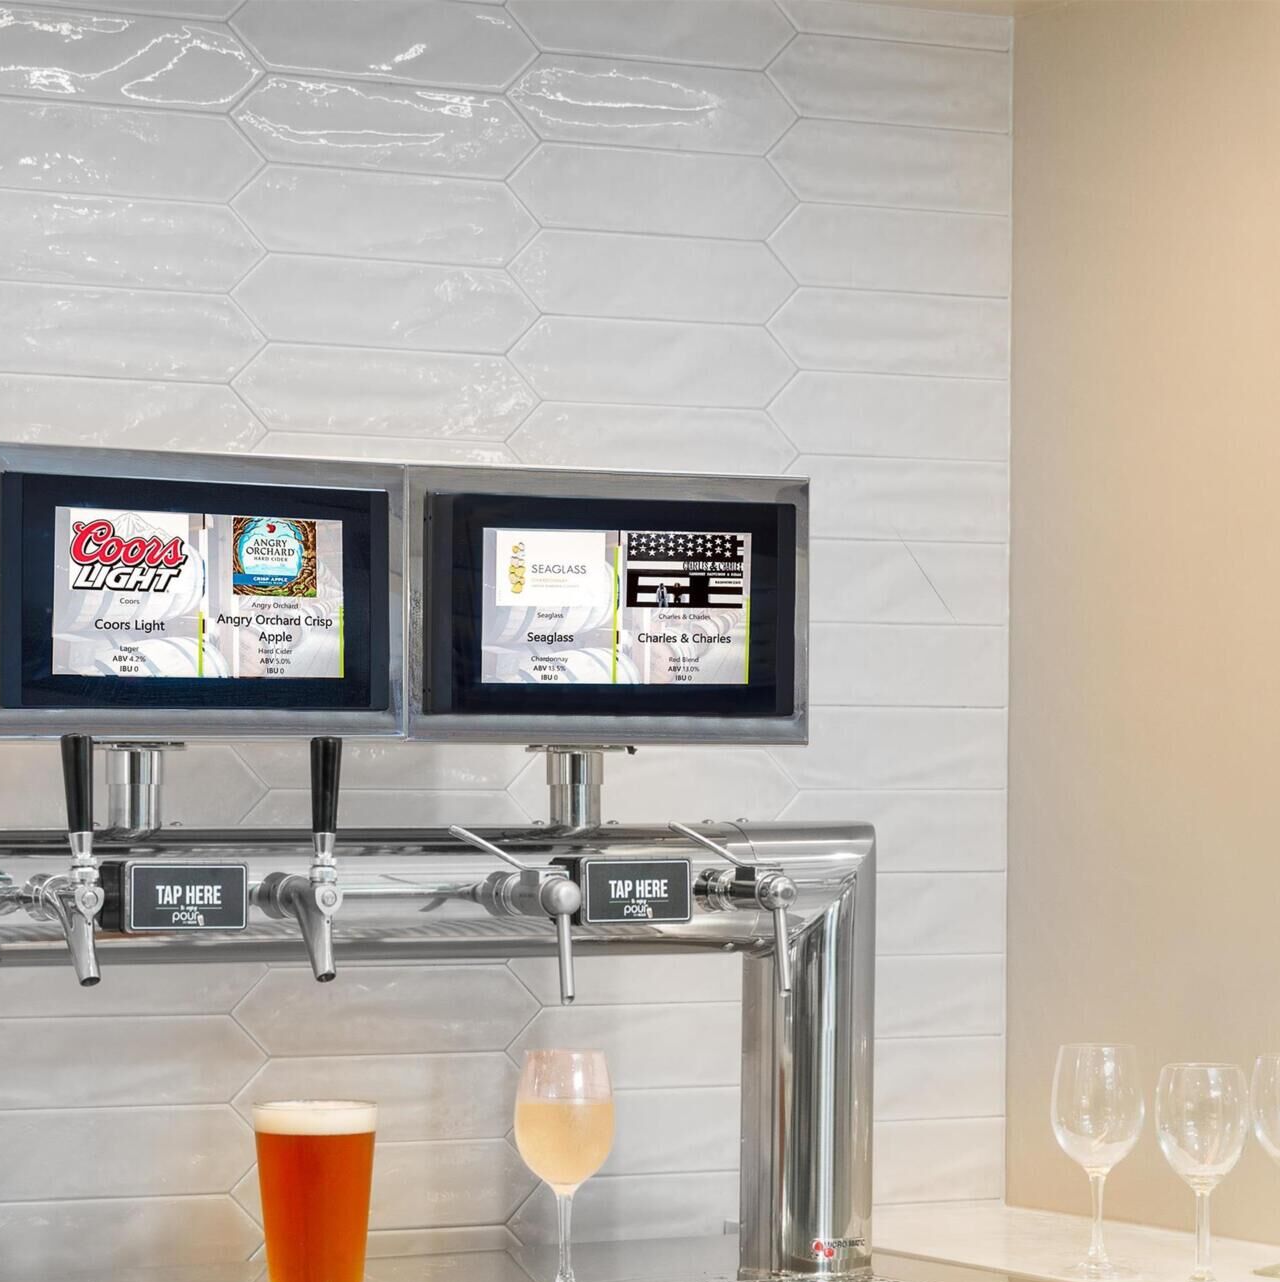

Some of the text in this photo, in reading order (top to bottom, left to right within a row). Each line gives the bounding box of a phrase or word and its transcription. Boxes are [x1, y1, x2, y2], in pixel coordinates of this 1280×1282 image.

[70, 519, 188, 568] Coors
[253, 539, 287, 547] ANGRY
[246, 546, 295, 556] ORCHARD
[531, 564, 587, 575] SEAGLASS
[72, 565, 181, 592] LIGHT
[119, 597, 140, 605] Coors
[252, 602, 299, 610] Angry Orchard
[216, 614, 333, 629] Angry Orchard Crisp
[536, 612, 565, 620] Seaglass
[94, 618, 166, 634] Coors Light
[258, 632, 293, 645] Apple
[527, 632, 574, 645] Seaglass
[637, 633, 732, 644] Charles & Charles
[119, 645, 140, 654] Lager
[112, 655, 128, 663] ABV
[530, 655, 569, 664] Chardonnay
[119, 665, 132, 673] IBU
[155, 884, 222, 905] TAP HERE
[609, 879, 668, 899] TAP HERE
[623, 904, 649, 916] pour
[172, 911, 200, 924] pour
